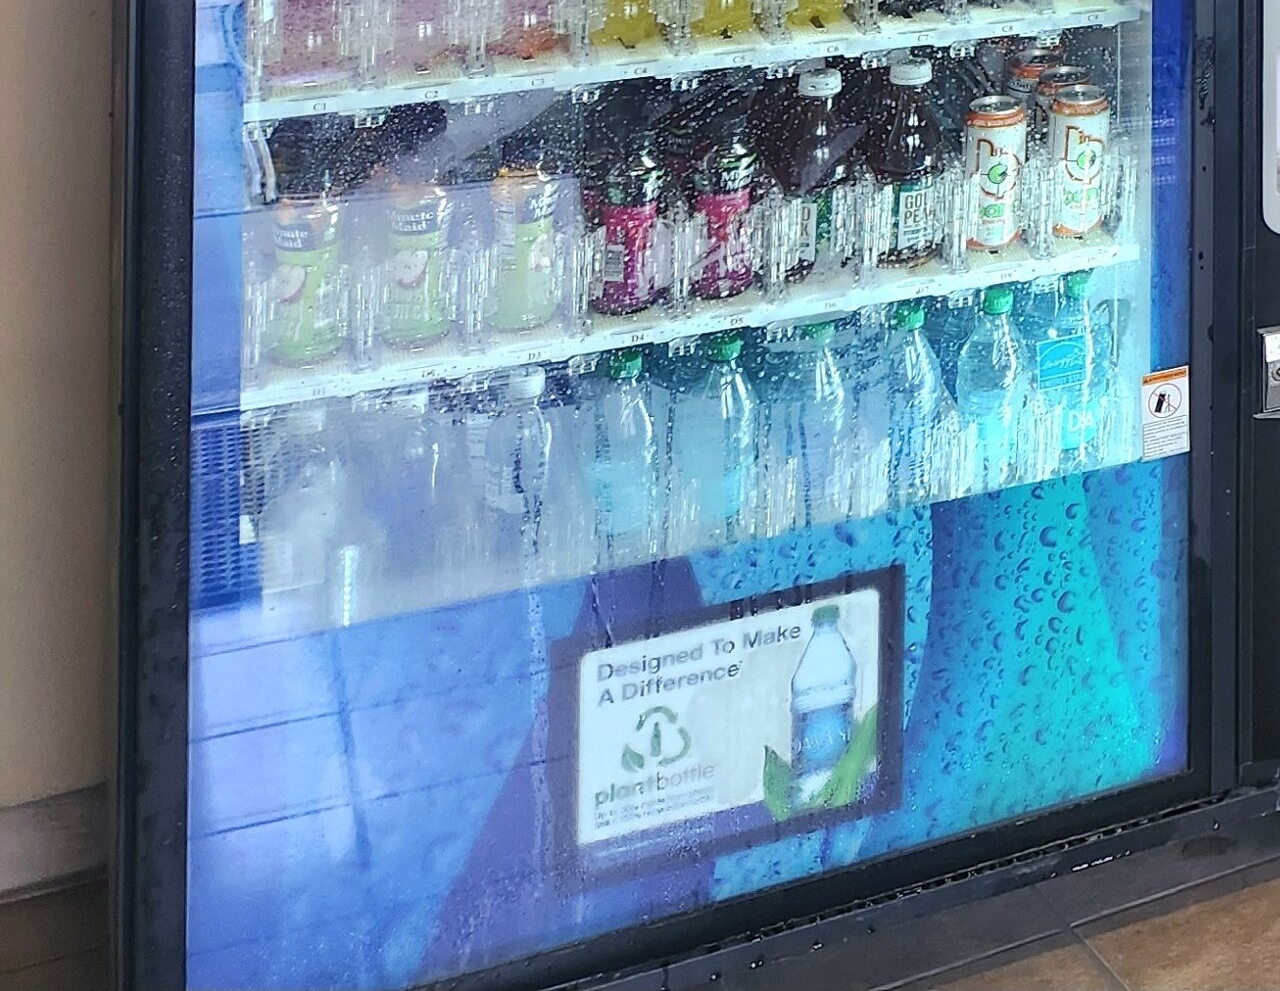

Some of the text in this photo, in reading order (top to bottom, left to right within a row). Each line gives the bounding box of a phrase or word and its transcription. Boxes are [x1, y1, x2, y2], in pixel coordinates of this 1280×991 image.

[596, 623, 802, 683] Designed To Make
[596, 660, 741, 707] A Difference
